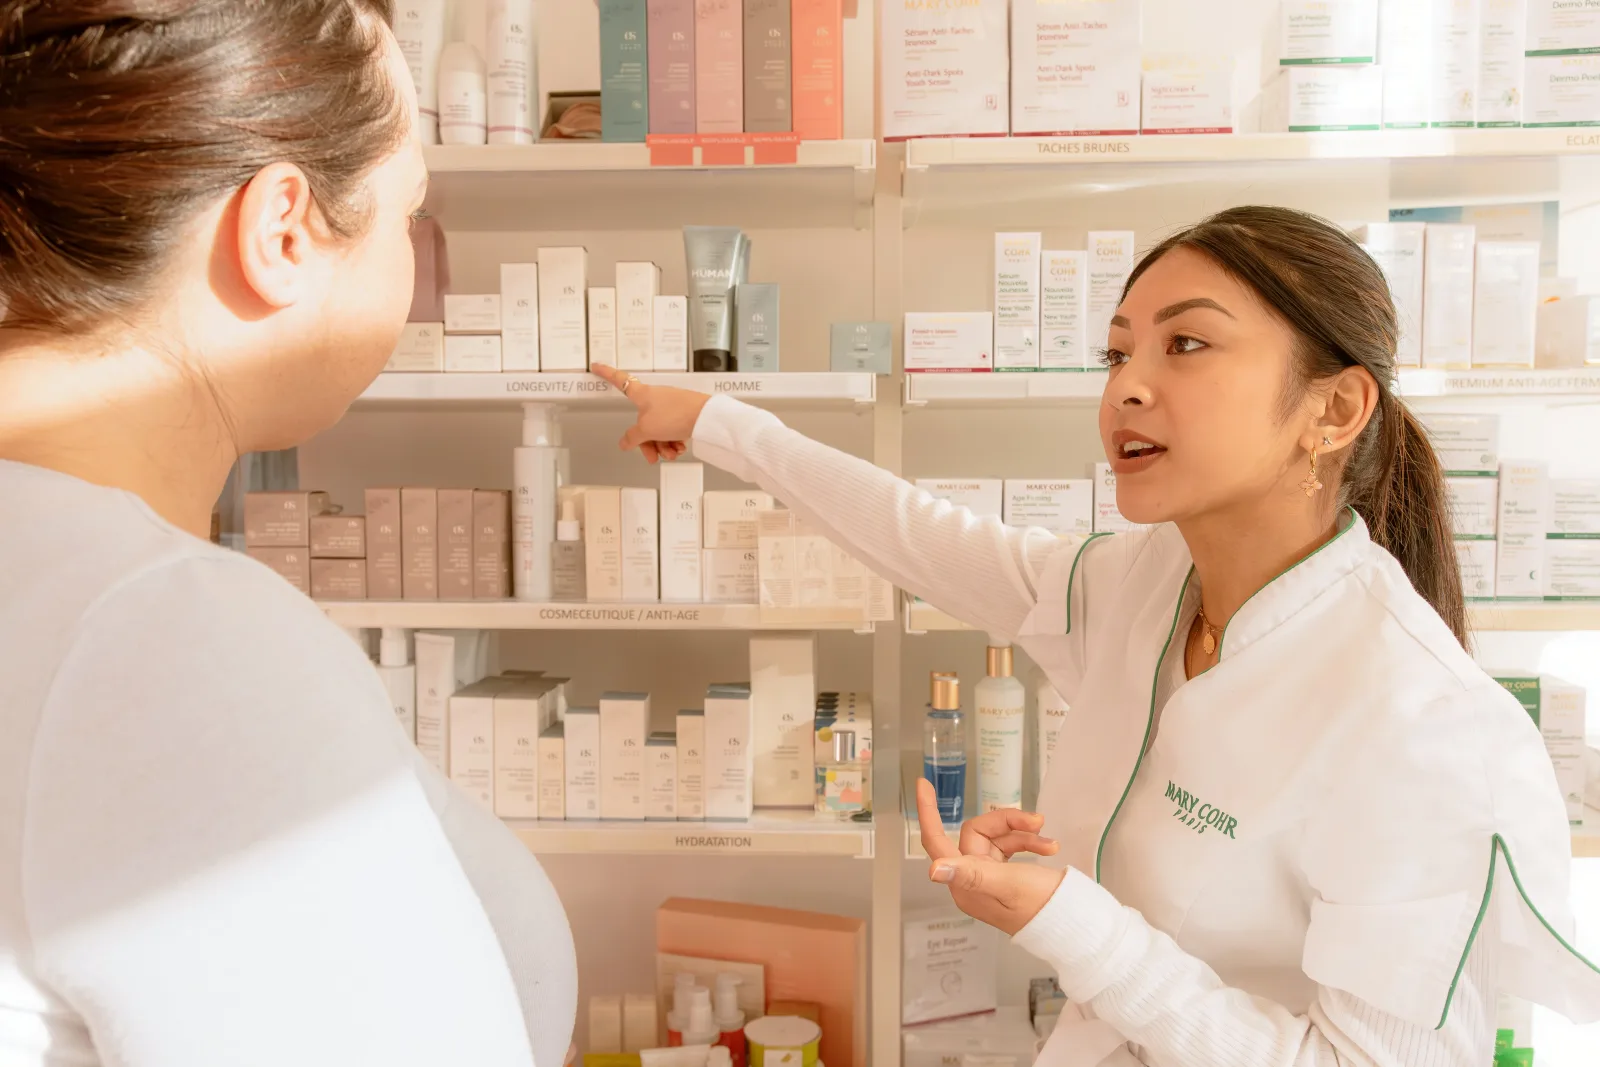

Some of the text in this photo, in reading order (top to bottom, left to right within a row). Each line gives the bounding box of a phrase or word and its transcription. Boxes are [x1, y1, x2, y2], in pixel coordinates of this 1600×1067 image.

[1552, 0, 1583, 9] Dermo
[1549, 74, 1580, 83] Dermo
[1566, 135, 1600, 147] ECLAT
[1037, 143, 1130, 154] TACHES BRUNES
[691, 269, 732, 278] HUMAN
[506, 380, 608, 393] LONGEVITE/ RIDES
[714, 380, 763, 392] HOMME
[1445, 377, 1600, 389] PREMIUM ANTI-AGE FERM
[1012, 495, 1025, 503] Age
[539, 608, 635, 622] COSMECEUTIQUE
[645, 609, 700, 621] ANTI-AGE
[979, 706, 1003, 716] MARY
[1164, 780, 1237, 839] MARY COHR
[1173, 809, 1207, 834] PARIS
[675, 836, 752, 848] HYDRATATION
[927, 939, 941, 952] Eye
